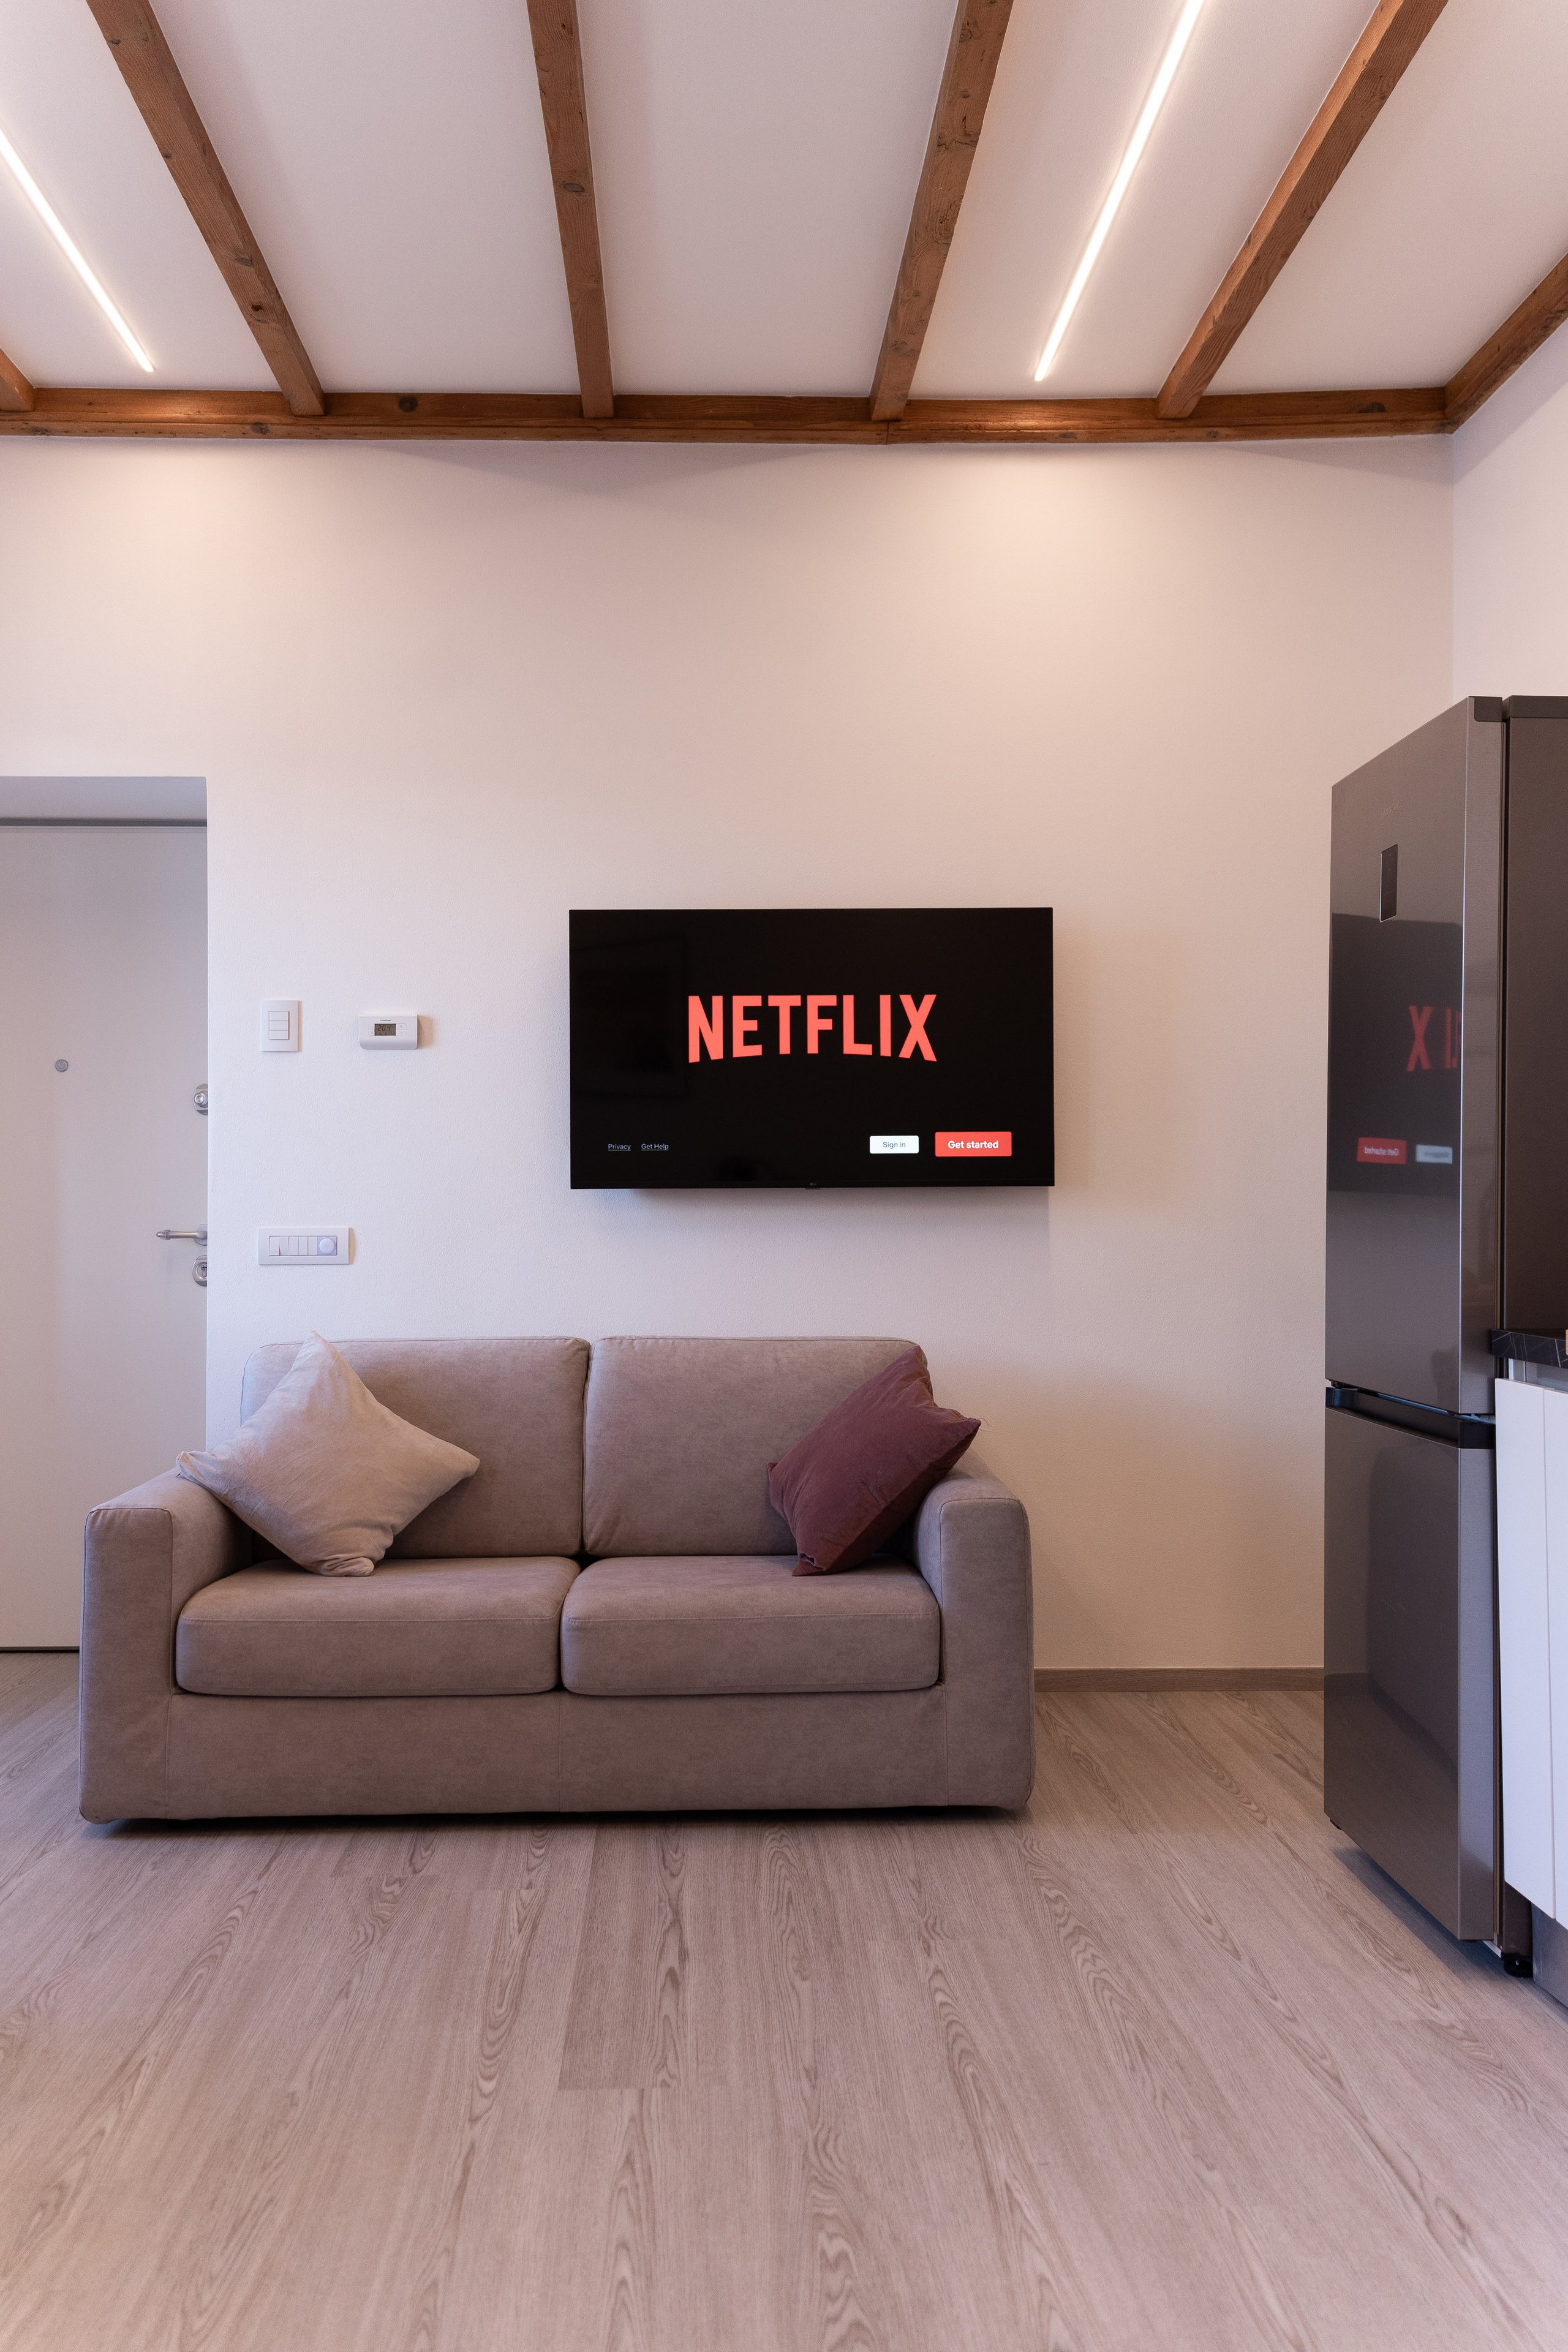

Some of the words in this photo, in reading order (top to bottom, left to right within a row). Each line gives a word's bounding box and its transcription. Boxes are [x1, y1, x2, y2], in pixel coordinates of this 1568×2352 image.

[688, 994, 937, 1063] NETFLIX
[948, 1140, 965, 1149] Get
[966, 1140, 999, 1149] started
